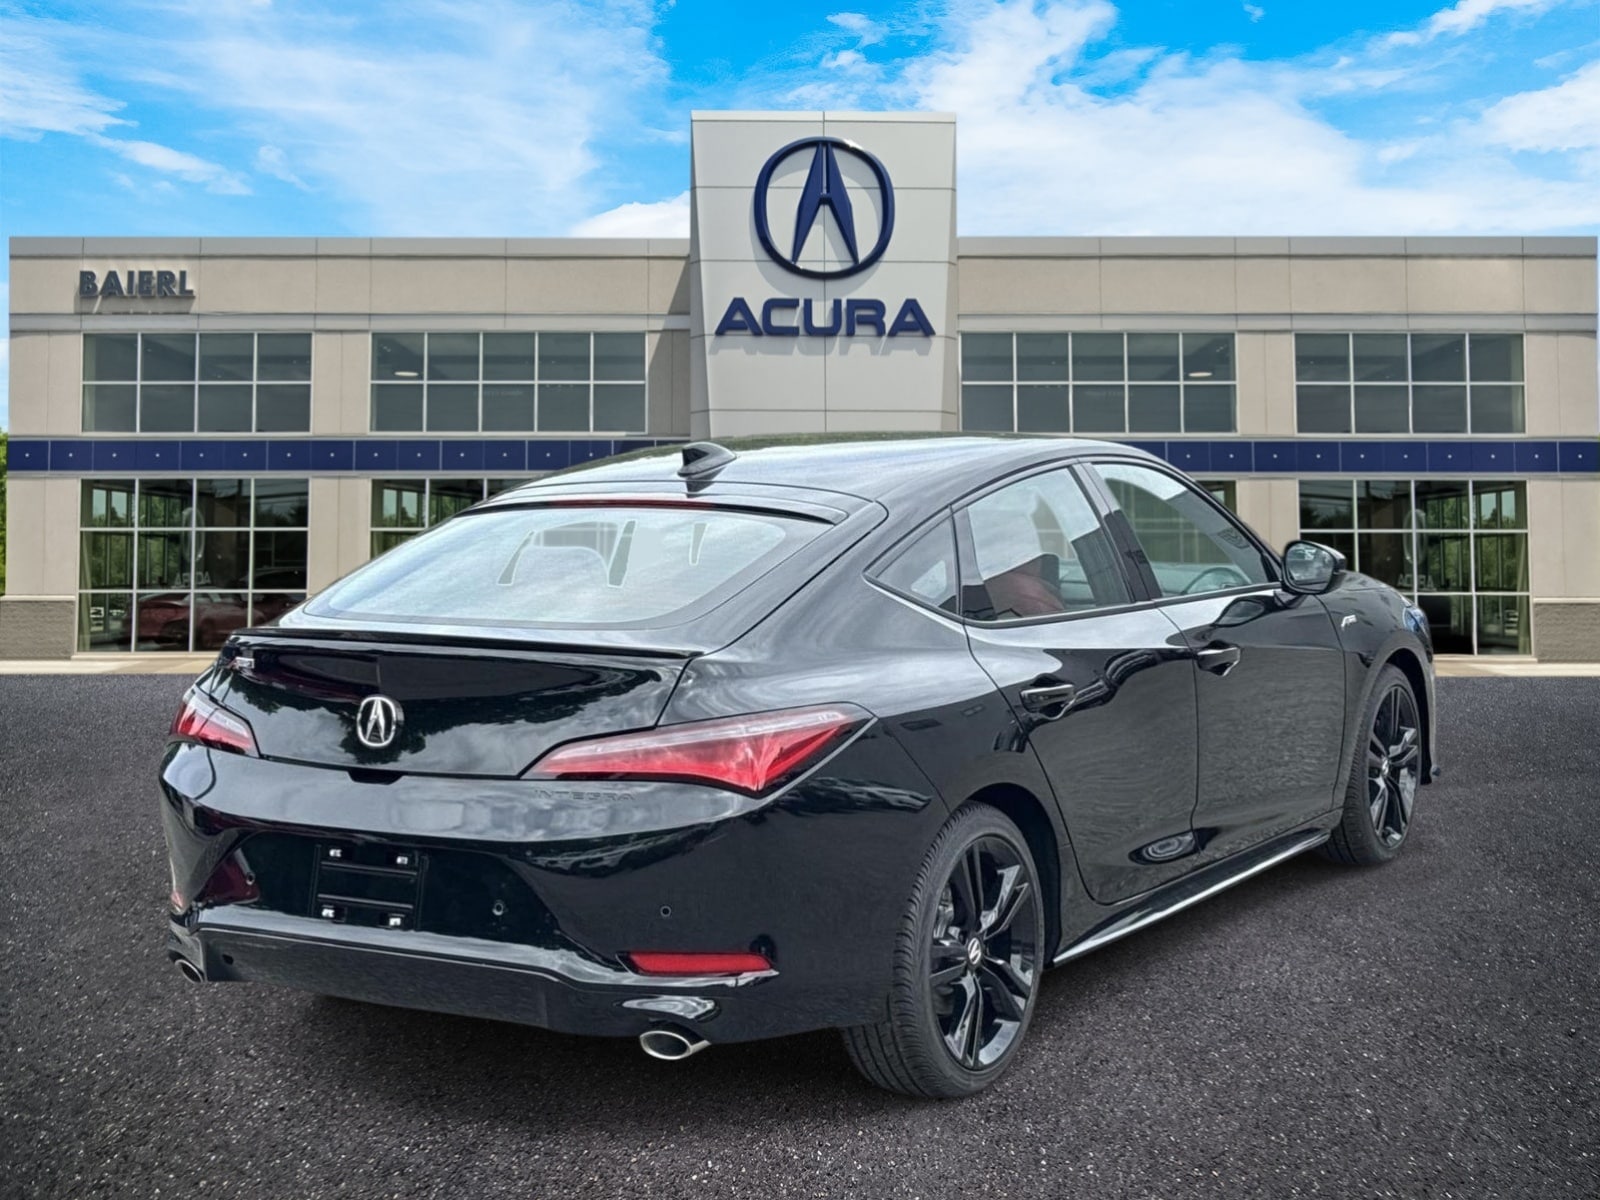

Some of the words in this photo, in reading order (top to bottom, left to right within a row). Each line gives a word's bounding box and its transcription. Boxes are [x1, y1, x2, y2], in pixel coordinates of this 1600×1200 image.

[79, 270, 195, 297] BAIERL
[715, 297, 936, 336] ACURA
[534, 789, 636, 801] INTEGRA
